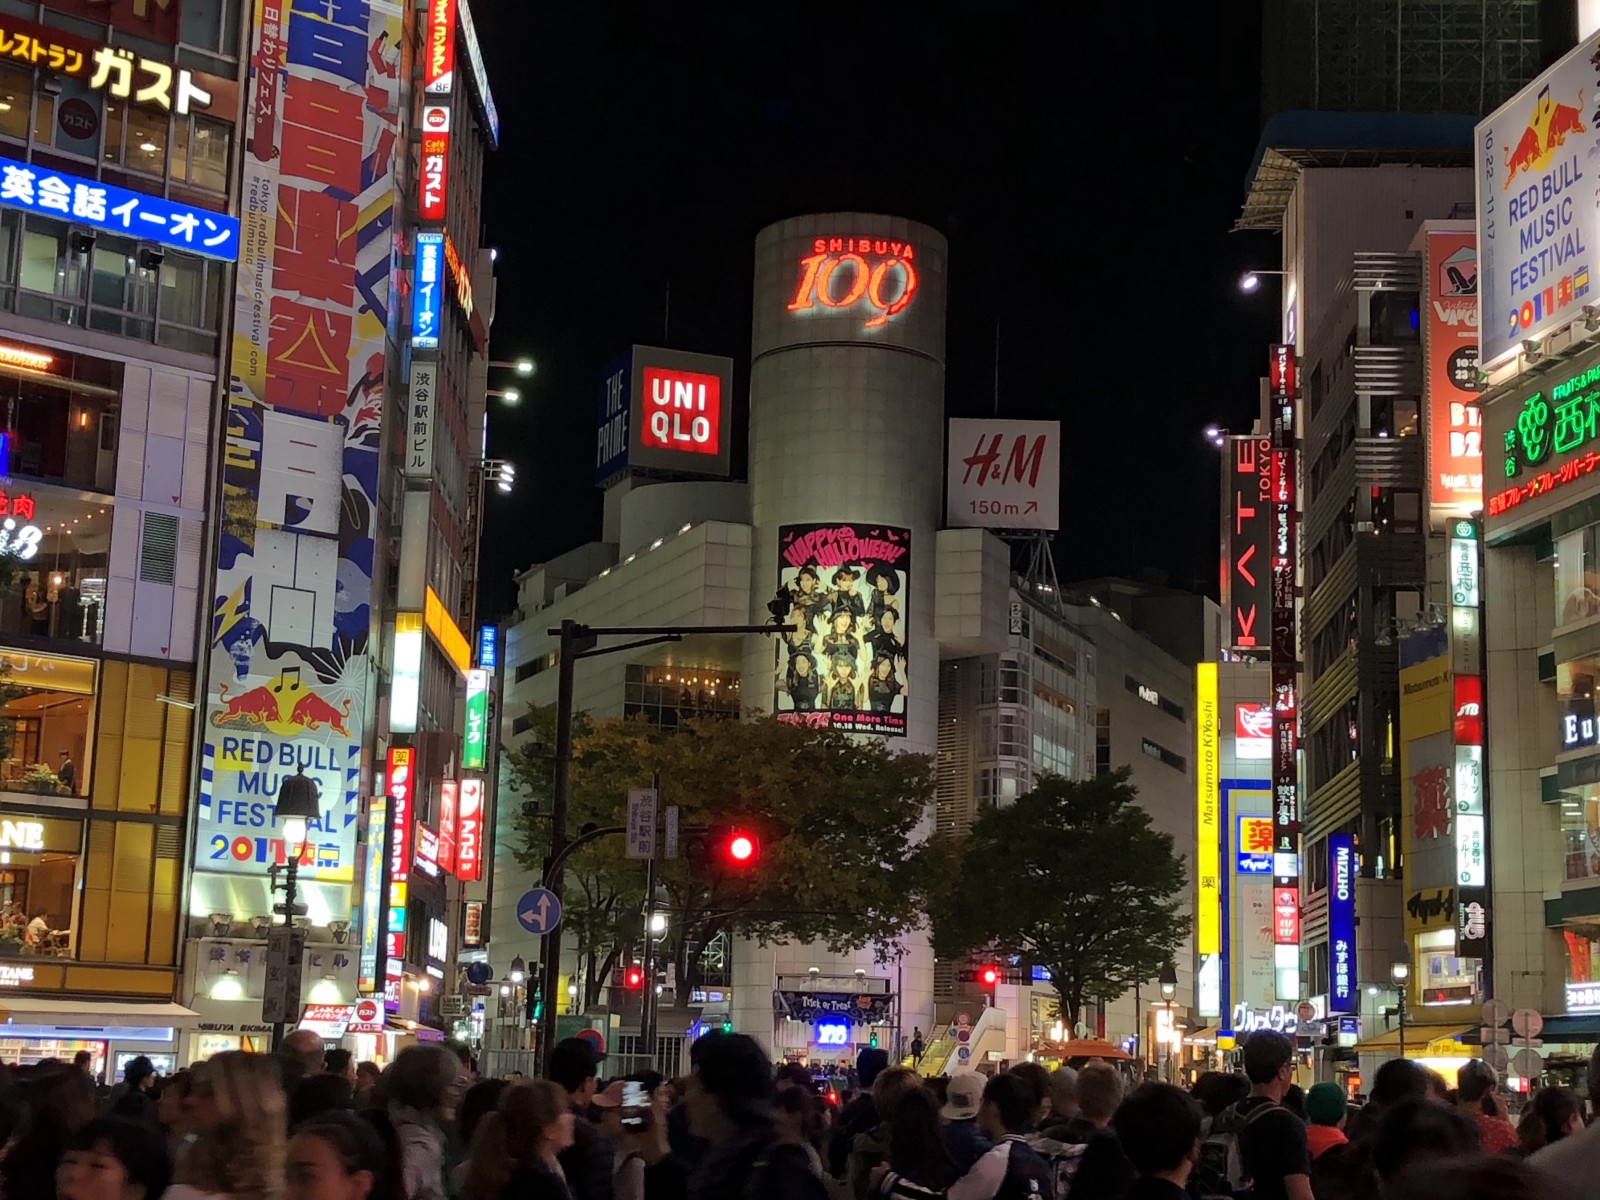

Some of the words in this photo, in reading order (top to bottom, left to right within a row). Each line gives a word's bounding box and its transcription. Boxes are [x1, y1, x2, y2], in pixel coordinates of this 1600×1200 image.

[91, 47, 211, 115] ガスト
[256, 6, 280, 124] 日替わりフェス。
[435, 83, 449, 92] 8F
[64, 114, 93, 129] ガスト
[1, 165, 231, 247] 英会話イーオン
[425, 155, 443, 208] ガスト
[1508, 185, 1539, 227] RED
[1541, 155, 1583, 208] BULL
[245, 175, 260, 265] #redbullmusic
[1519, 197, 1573, 254] MUSIC
[814, 238, 914, 260] SHIBUYA
[1510, 227, 1586, 297] FESTIVAL
[787, 253, 917, 327] 109
[606, 368, 623, 419] THE
[652, 378, 706, 411] UNI
[411, 372, 431, 468] 渋谷駅前ビル
[597, 409, 628, 469] PRIME
[651, 411, 710, 443] QLO
[962, 433, 1047, 489] H&M
[1259, 440, 1271, 502] TOKYO
[783, 528, 841, 569] HAPPY
[467, 708, 482, 744] レイク
[1203, 700, 1214, 748] KiYoshi
[1457, 703, 1480, 716] JTB
[1564, 714, 1600, 744] Eu
[222, 736, 274, 764] RED
[279, 742, 341, 771] BULL
[1470, 759, 1480, 794] フルーツ
[238, 770, 324, 798] MUC
[1202, 748, 1214, 827] Matsumoto
[218, 800, 337, 833] FESTAL
[460, 820, 476, 859] アコム
[639, 794, 652, 853] 渋谷駅前
[1201, 875, 1215, 889] 薬
[1337, 847, 1349, 901] MIZUHO
[1335, 941, 1349, 998] みずほ銀行
[358, 1008, 375, 1016] ガスト
